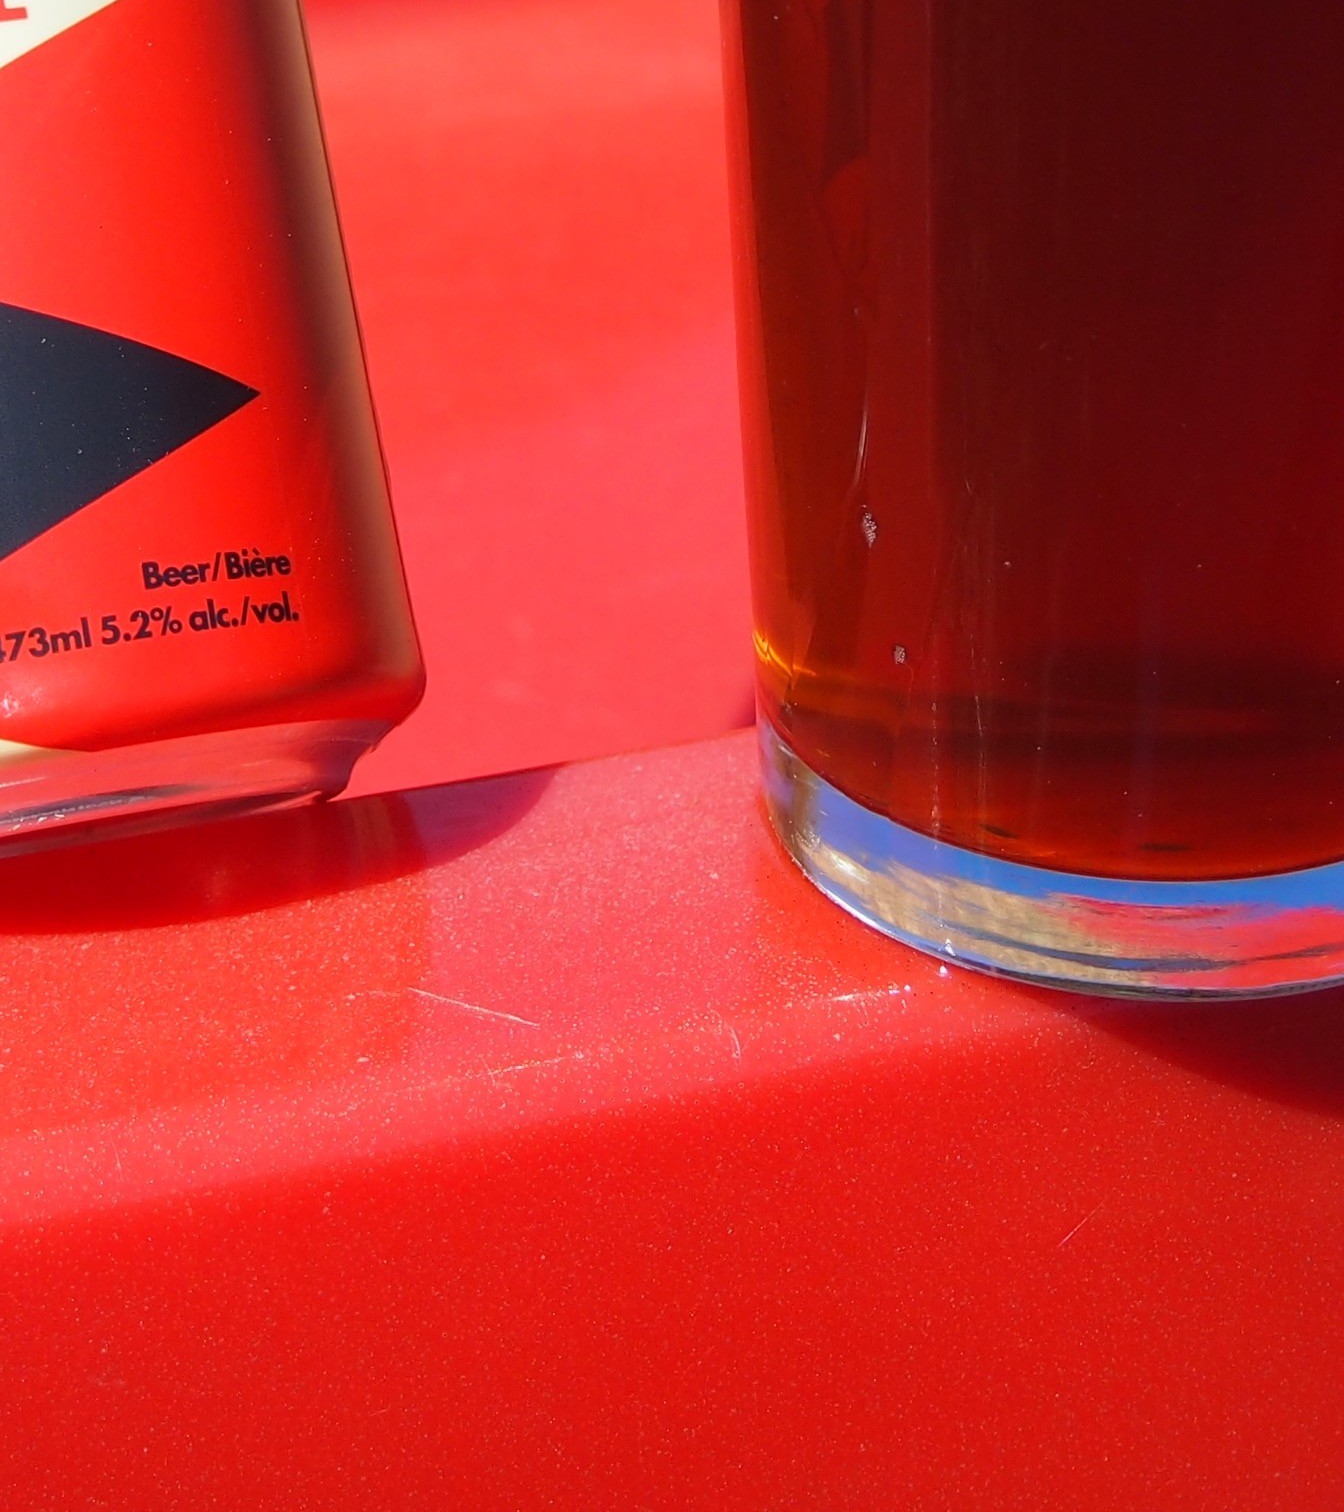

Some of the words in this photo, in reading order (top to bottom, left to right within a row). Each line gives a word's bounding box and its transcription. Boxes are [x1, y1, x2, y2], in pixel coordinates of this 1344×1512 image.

[141, 547, 292, 590] Beer/Bière
[100, 605, 183, 646] 5.2%
[188, 590, 300, 631] alc./vol.
